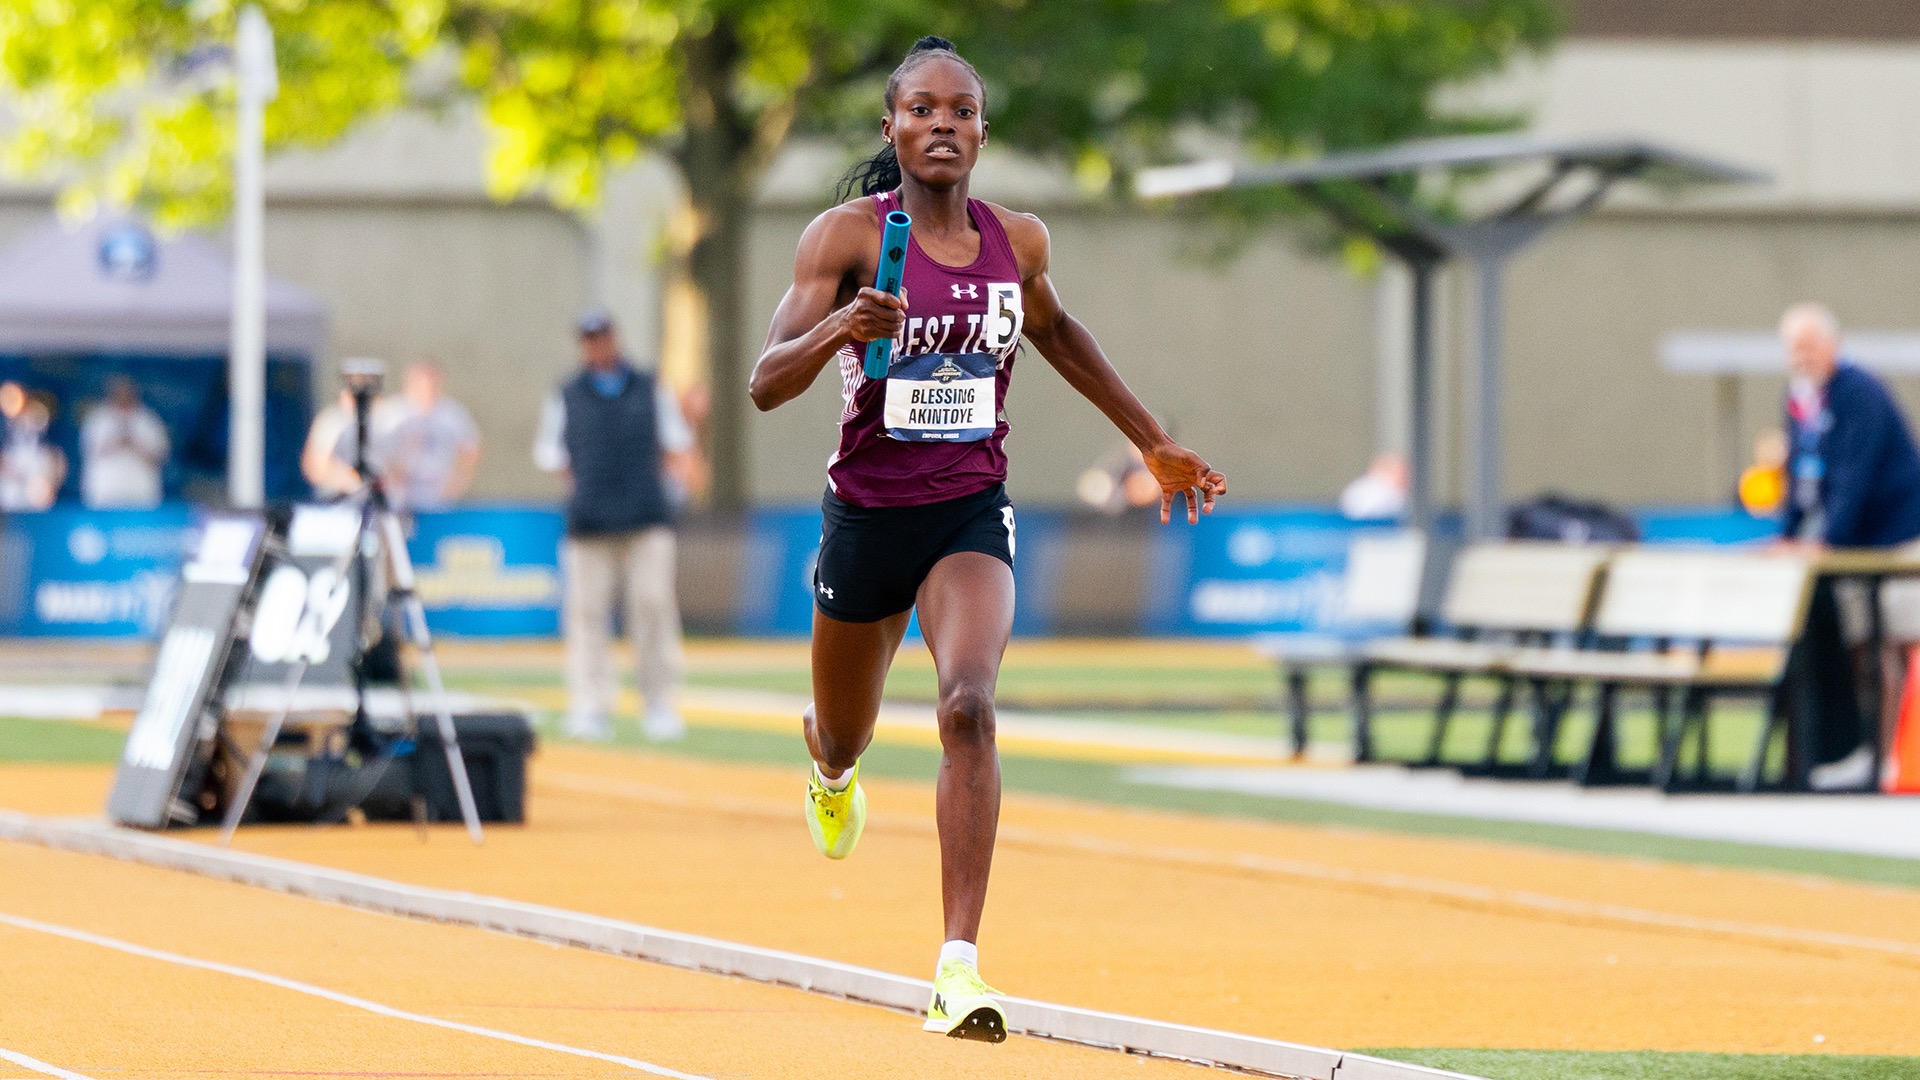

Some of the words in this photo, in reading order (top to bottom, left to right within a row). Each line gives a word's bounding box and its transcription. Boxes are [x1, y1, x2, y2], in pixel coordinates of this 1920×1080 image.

[997, 290, 1017, 344] 5
[911, 388, 975, 405] BLESSING
[908, 408, 974, 425] AKINTOYE
